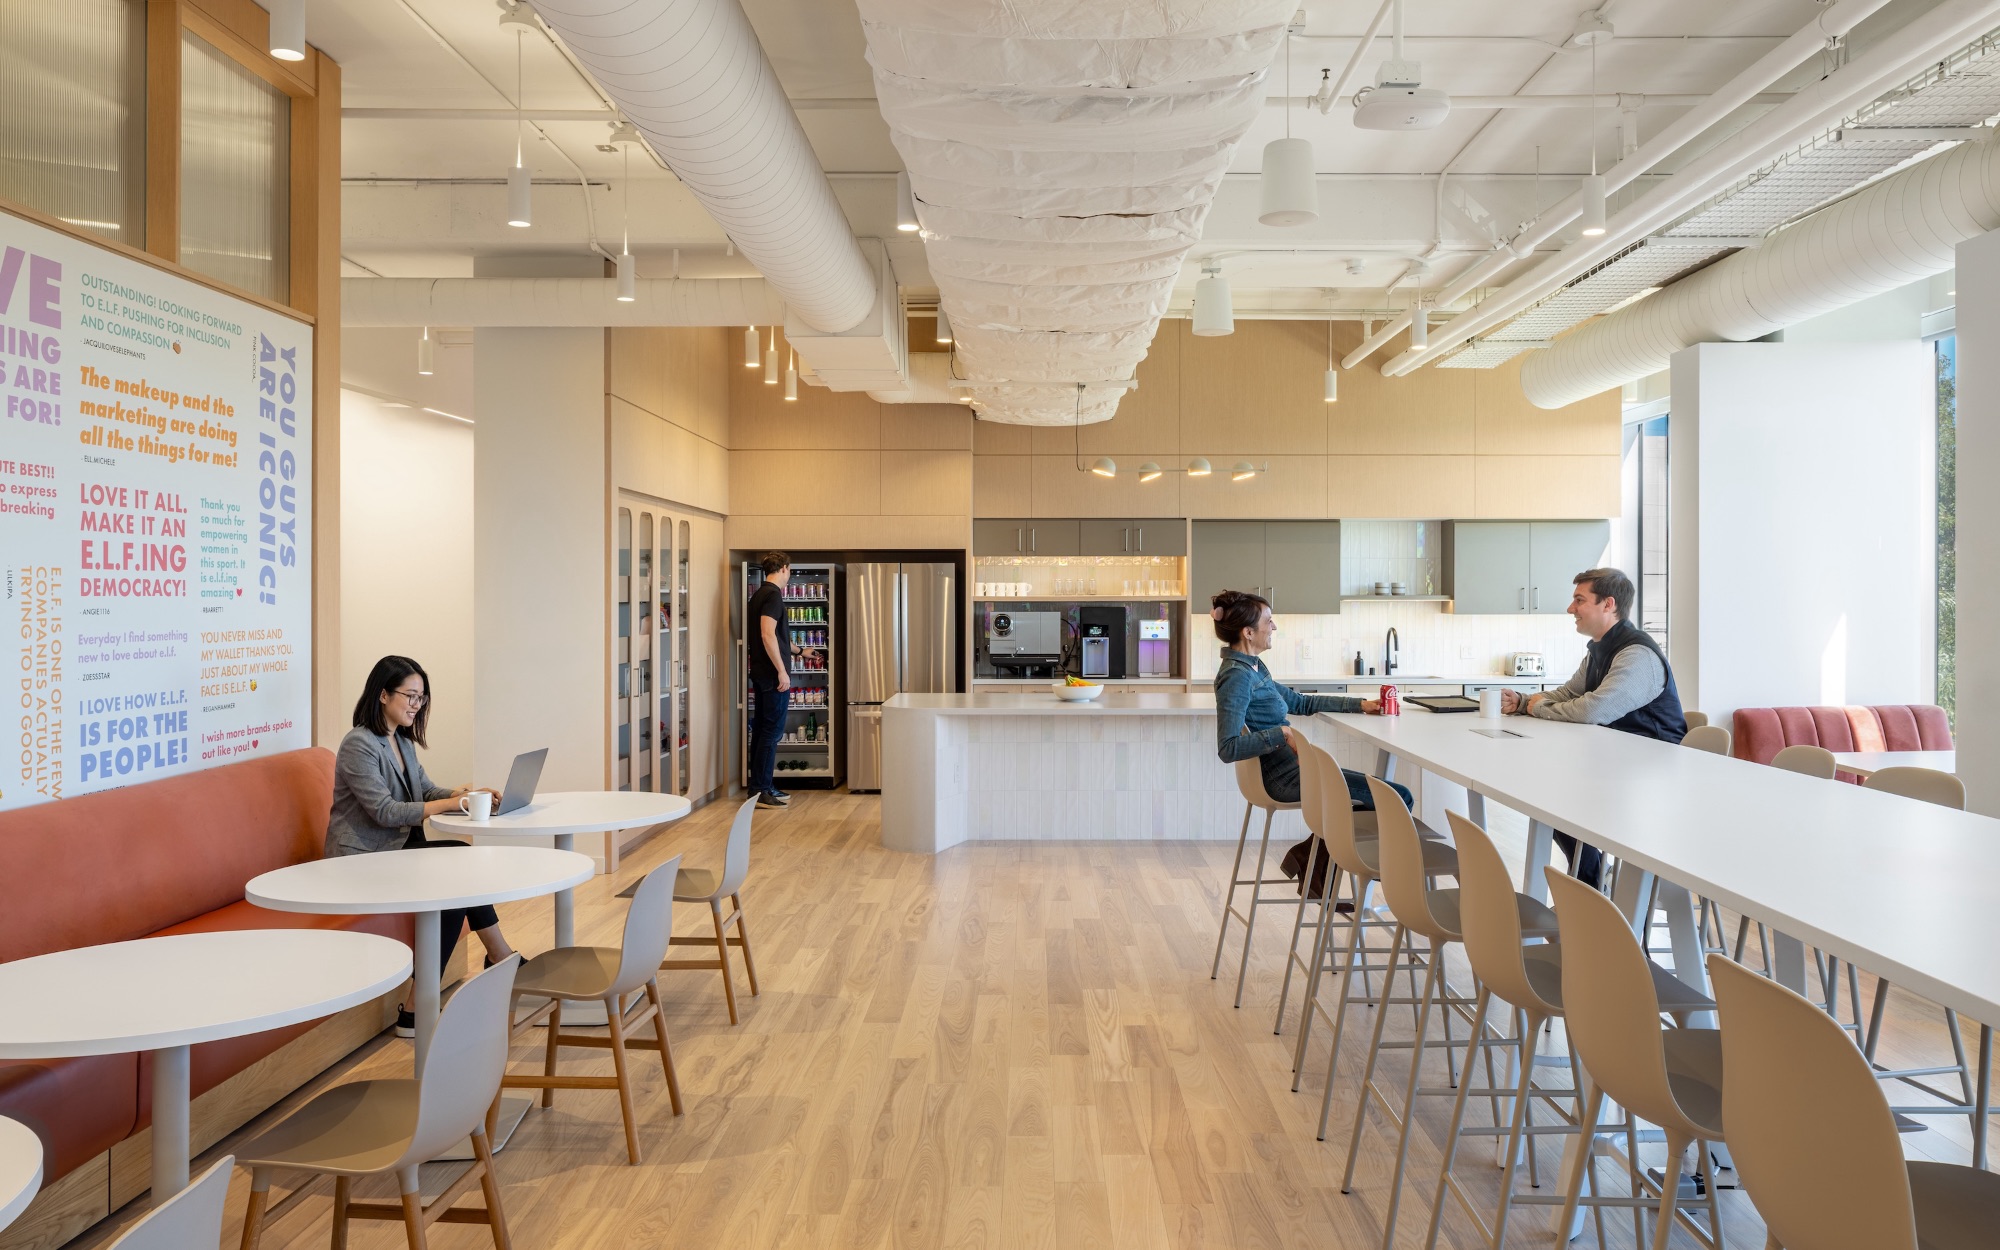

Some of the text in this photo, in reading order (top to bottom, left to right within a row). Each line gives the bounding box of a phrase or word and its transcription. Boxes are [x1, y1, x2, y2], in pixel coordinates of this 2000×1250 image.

[82, 274, 242, 336] OUTSTANDING! LOOKING FORWARD
[80, 293, 230, 349] TO E.L.F. PUSHING FOR INCLUSION
[80, 314, 170, 350] AND COMPASSION
[0, 324, 61, 364] ING
[14, 364, 61, 396] ARE
[80, 366, 234, 417] The makeup and the
[8, 394, 61, 426] FOR!
[80, 400, 237, 448] marketing are doing
[80, 425, 237, 468] all the things for me!
[280, 346, 296, 568] YOU GUYS
[0, 460, 54, 478] TE BEST!!
[259, 332, 276, 606] ARE ICONIC!
[10, 484, 57, 499] express
[81, 483, 187, 514] LOVE IT ALL.
[0, 498, 54, 520] breaking
[200, 498, 240, 514] Thank you
[80, 511, 185, 538] MAKE IT AN
[200, 514, 245, 526] so much for
[200, 530, 248, 544] empowering
[200, 544, 238, 554] women in
[82, 540, 186, 572] E.L.F.ING
[200, 557, 246, 571] this sport. It
[81, 578, 186, 597] DEMOCRACY!
[200, 572, 238, 586] is e.l.f.ing
[200, 587, 234, 600] amazing
[78, 630, 188, 647] Everyday I find something
[201, 629, 282, 644] YOU NEVER MISS AND
[78, 646, 176, 663] new to love about e.l.f.
[201, 644, 293, 662] MY WALLET THANKS YOU.
[21, 565, 32, 786] TRYING TO DO GOOD.
[36, 566, 47, 795] COMPANIES ACTUALLY
[200, 660, 288, 680] JUST ABOUT MY WHOLE
[51, 567, 62, 800] E.L.F. IS ONE OF THE FEW
[201, 681, 248, 697] FACE IS E.L.F.
[80, 690, 187, 715] I LOVE HOW E.L.F.
[80, 710, 187, 747] IS FOR THE
[202, 719, 292, 743] I wish more brands spoke
[81, 738, 188, 782] PEOPLE!
[202, 741, 250, 759] out like you!
